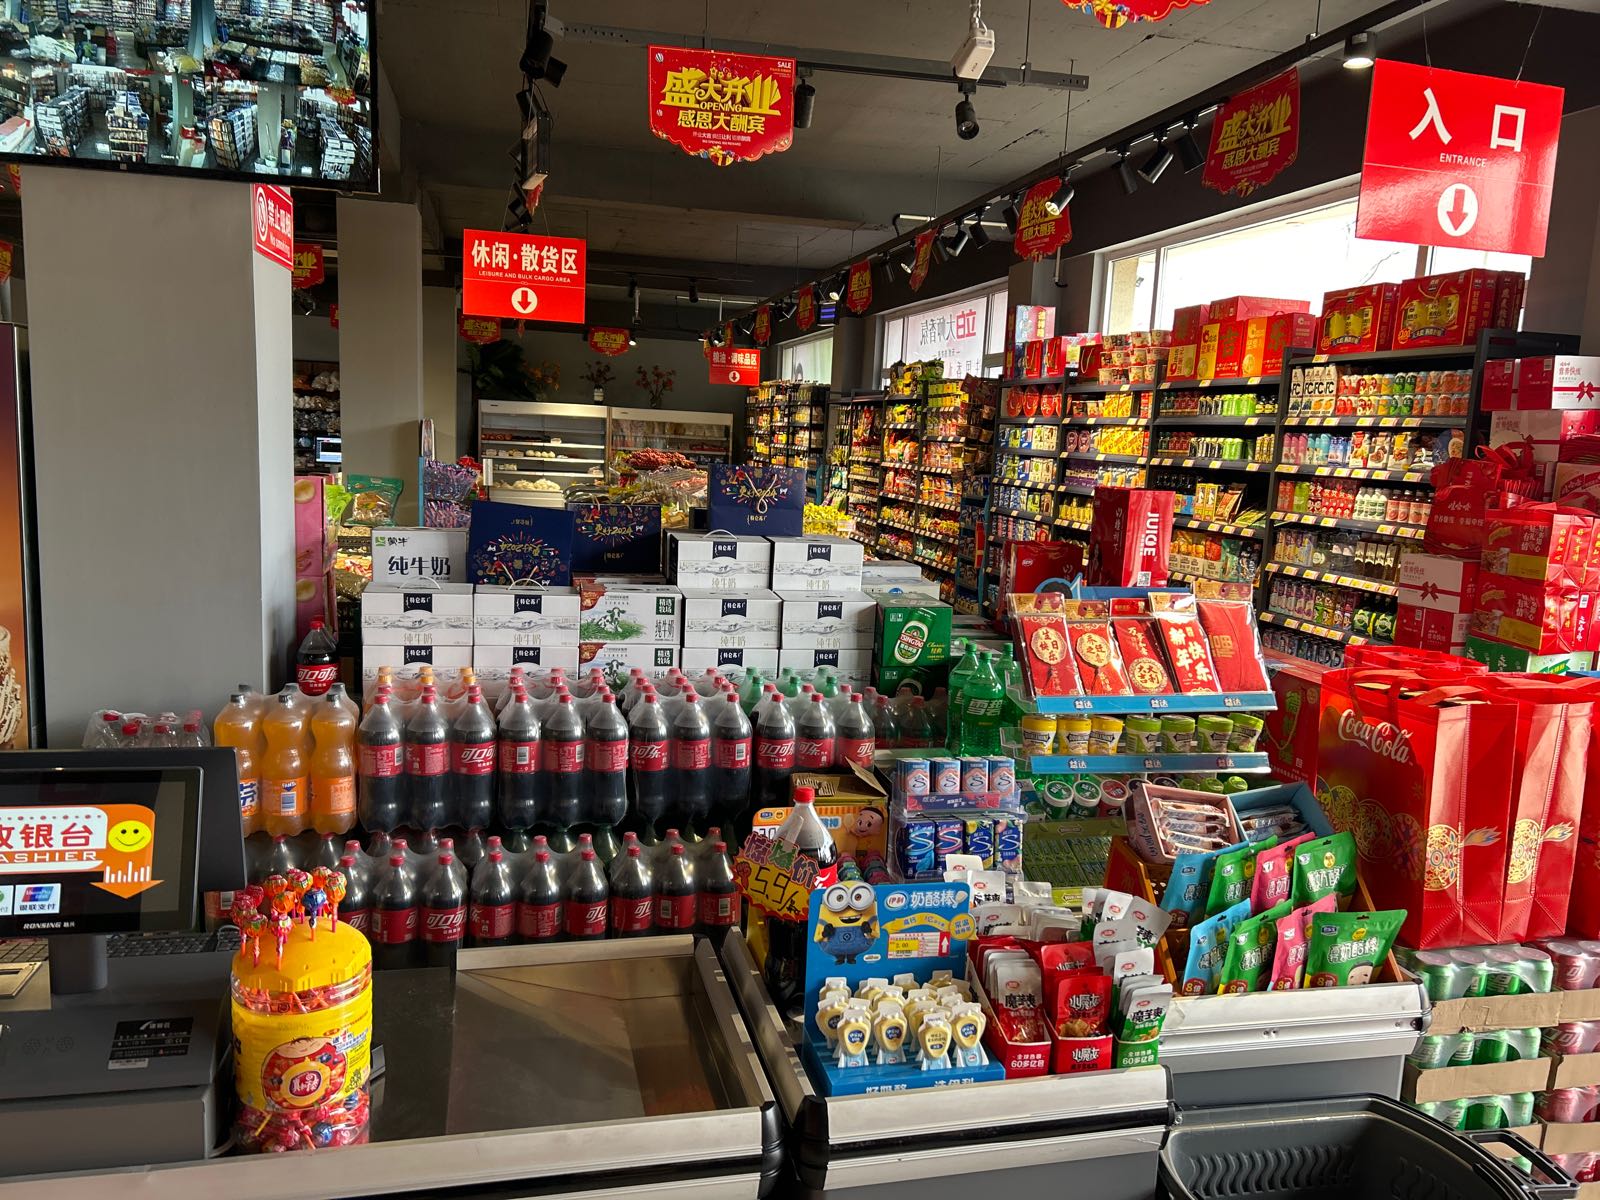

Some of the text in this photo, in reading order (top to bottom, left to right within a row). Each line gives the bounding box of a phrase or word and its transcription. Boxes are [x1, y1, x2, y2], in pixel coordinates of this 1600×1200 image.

[777, 61, 792, 69] SALE
[659, 66, 781, 116] 盛大开业
[700, 101, 742, 113] OPENING
[677, 109, 766, 135] 感恩大酬宾
[1214, 92, 1291, 154] 盛大开业
[1409, 87, 1526, 152] 入口
[1439, 152, 1487, 168] ENTRANCE
[268, 198, 291, 238] 禁止吸烟
[471, 240, 578, 274] 休闲·散货区
[388, 556, 451, 575] 纯牛奶
[298, 667, 338, 682] 可口可乐
[967, 699, 1003, 716] 雪碧
[20, 903, 55, 911] 银联支付
[889, 895, 904, 904] 伊利
[910, 891, 957, 908] 奶酪棒
[1005, 994, 1036, 1008] 魔芋爽
[1132, 1006, 1166, 1022] 魔芋爽
[1011, 1059, 1045, 1068] 60多亿包
[1122, 1055, 1155, 1065] 60多亿包
